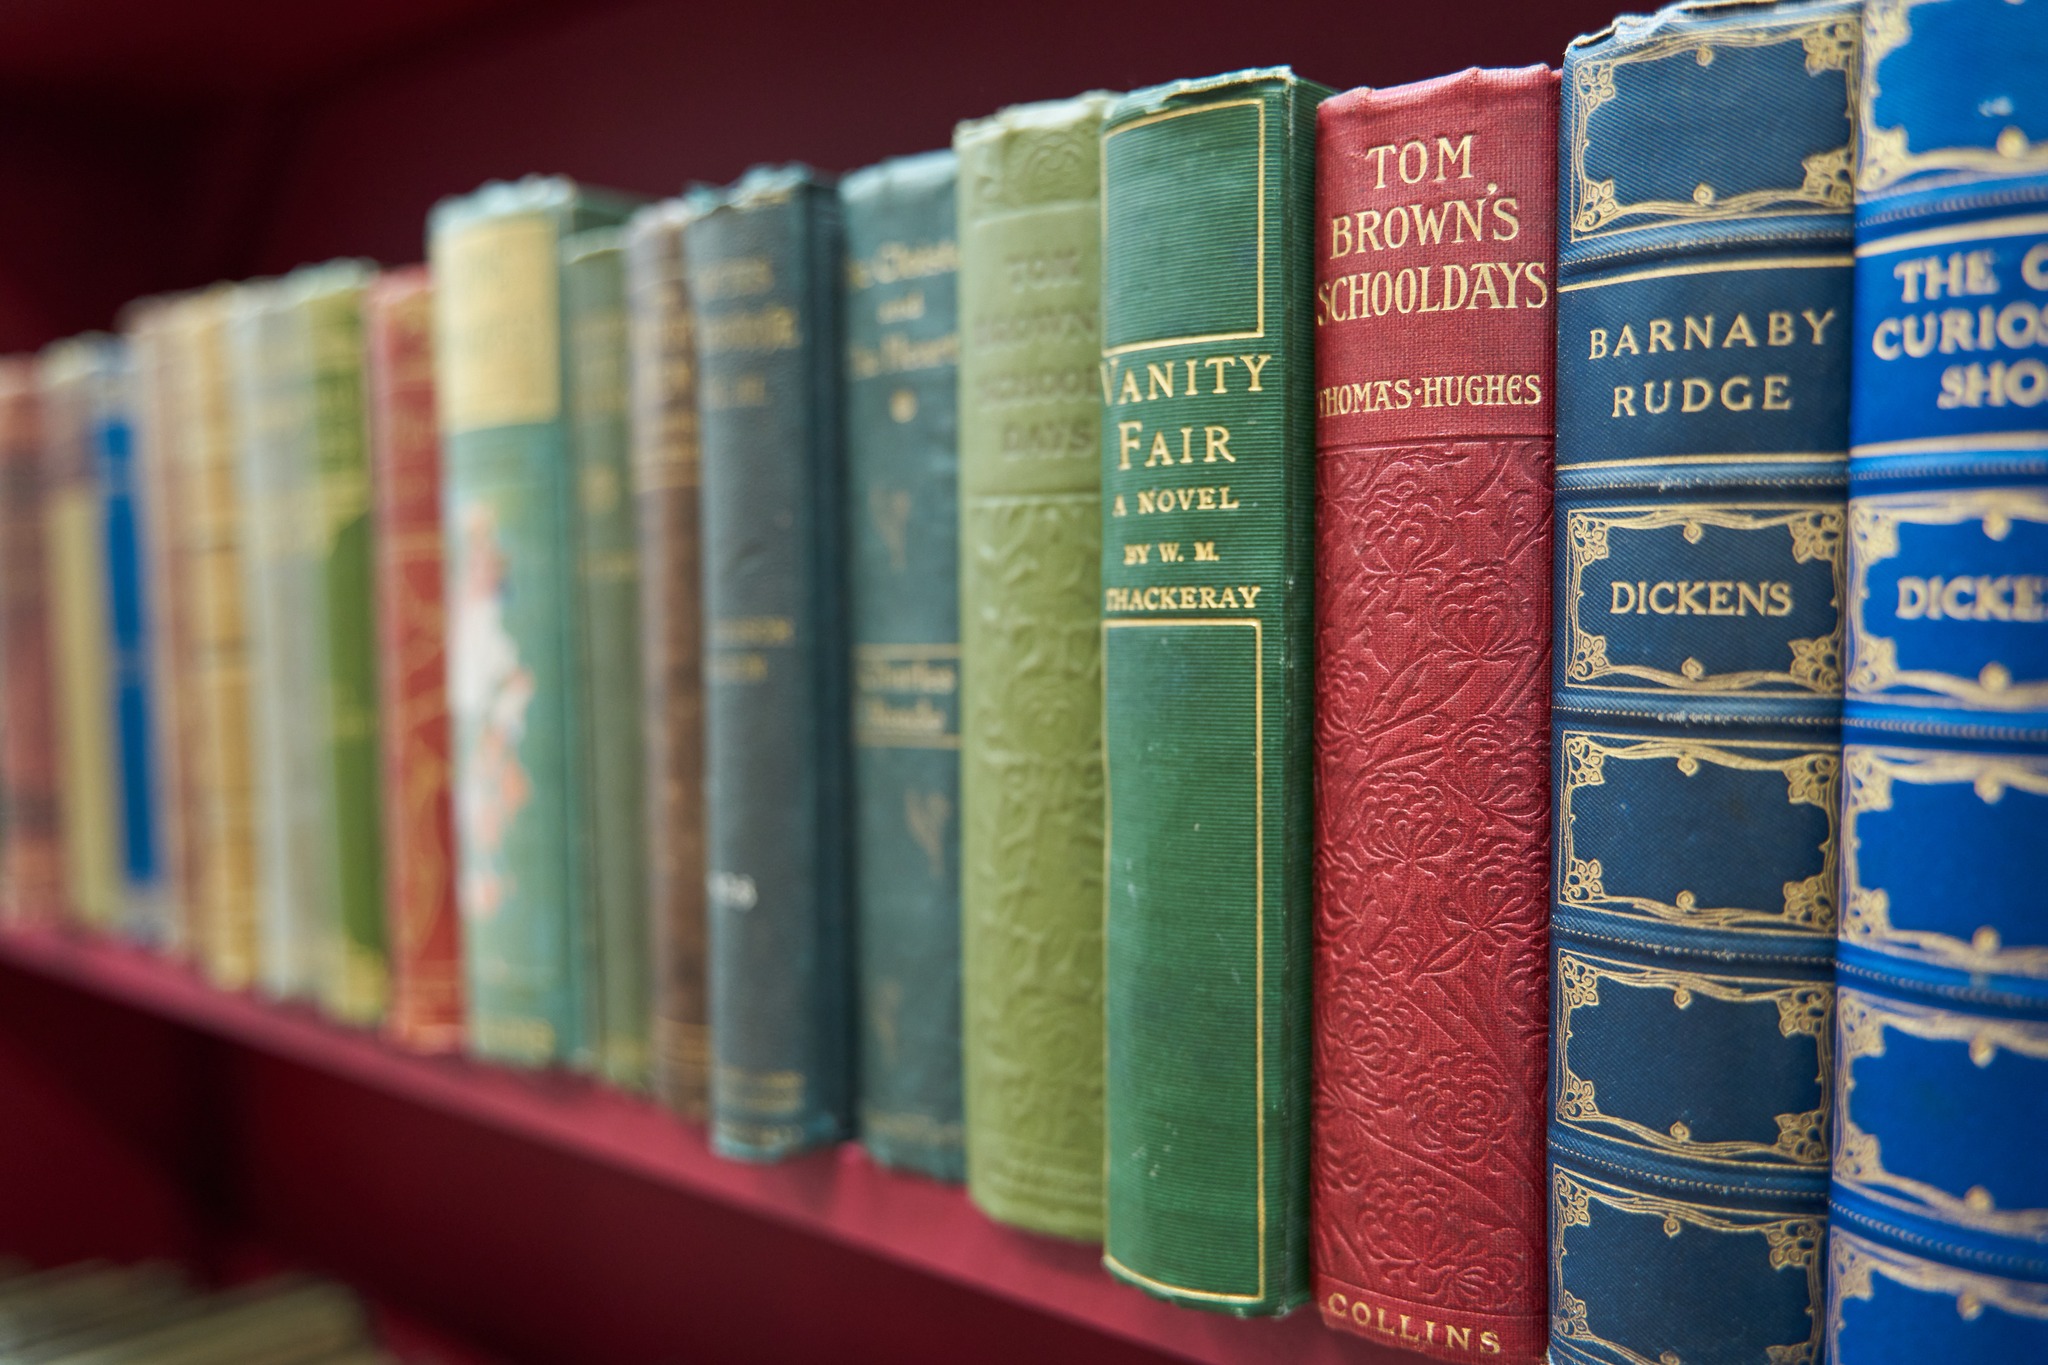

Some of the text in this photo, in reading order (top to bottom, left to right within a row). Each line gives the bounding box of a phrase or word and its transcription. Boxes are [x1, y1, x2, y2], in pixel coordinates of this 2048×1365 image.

[1366, 135, 1474, 190] TOM
[1330, 182, 1520, 259] BROWN'S
[1316, 262, 1548, 326] SCHOOLDAYS
[1893, 248, 2000, 304] THE
[1588, 309, 1837, 361] BARNABY
[1100, 354, 1272, 406] VANITY
[1611, 375, 1793, 418] RUDGE
[1118, 420, 1236, 471] FAIR
[1112, 486, 1240, 517] A NOVEL
[1123, 541, 1220, 566] BY W. M.
[1105, 586, 1261, 612] THACKERAY
[1609, 580, 1793, 618] DICKENS
[1895, 574, 2048, 622] DICKE
[1328, 1292, 1501, 1354] COLLINS
